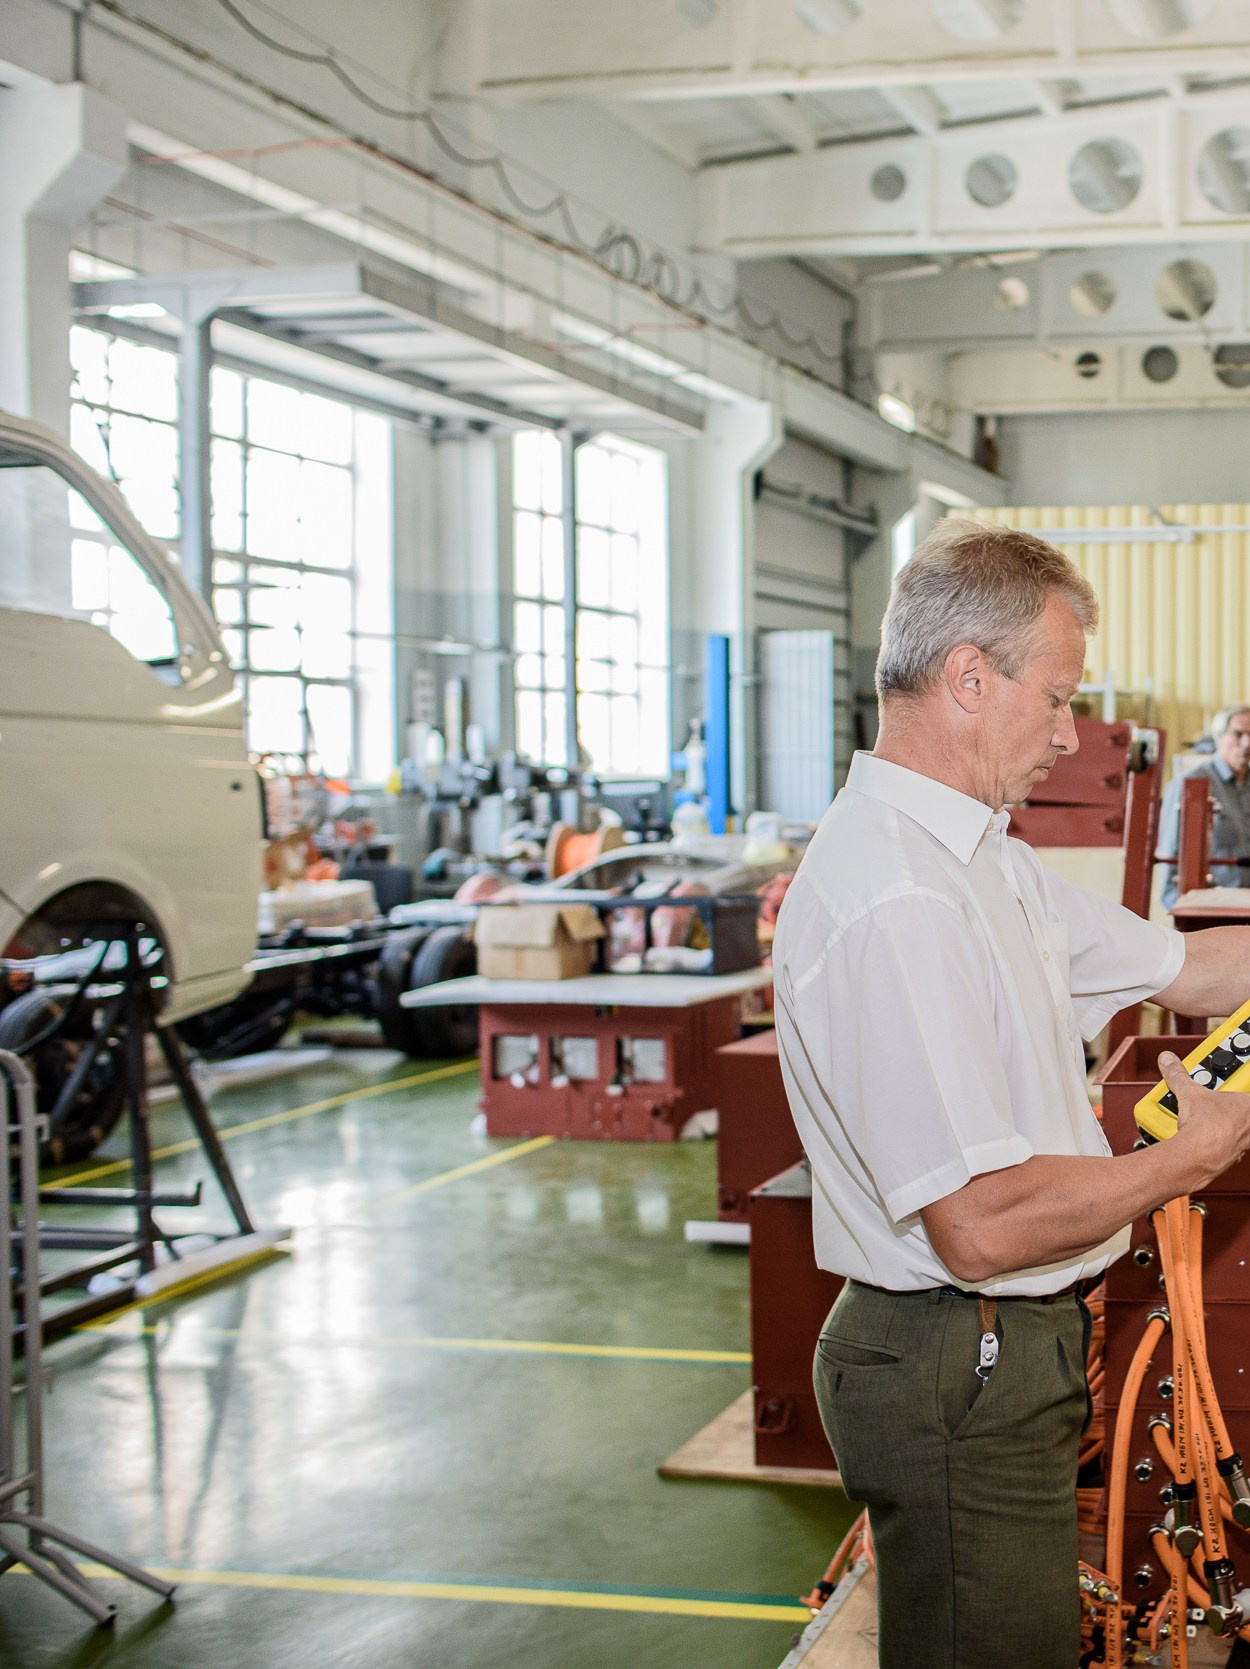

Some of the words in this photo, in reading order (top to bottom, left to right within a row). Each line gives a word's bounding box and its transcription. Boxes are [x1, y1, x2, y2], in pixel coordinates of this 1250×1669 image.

[1215, 1440, 1223, 1453] K2
[1179, 1461, 1186, 1473] K2
[1212, 1537, 1220, 1553] K2
